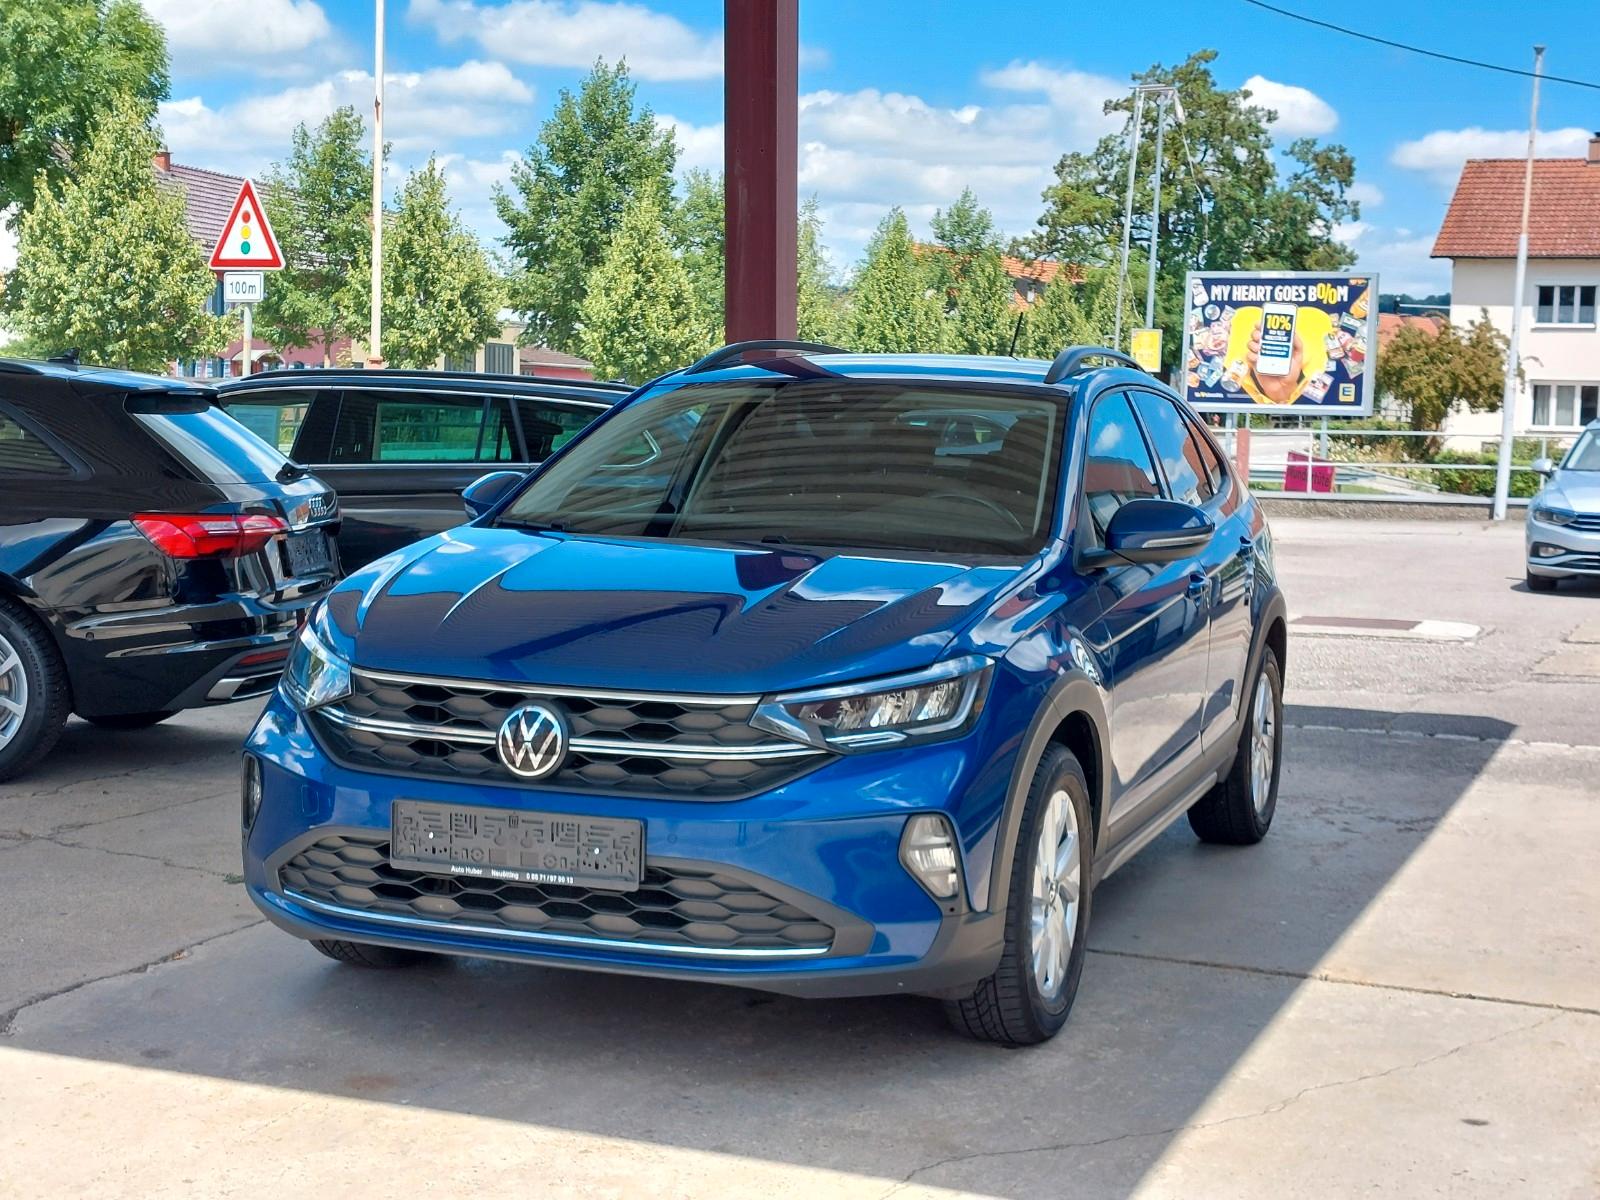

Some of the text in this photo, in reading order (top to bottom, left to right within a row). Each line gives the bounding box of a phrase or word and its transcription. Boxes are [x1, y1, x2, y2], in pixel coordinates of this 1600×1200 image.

[229, 281, 256, 294] 100m
[1211, 285, 1230, 301] MY
[1232, 285, 1272, 302] HEART
[1275, 286, 1306, 302] GOES
[1265, 313, 1292, 331] 10%
[450, 865, 464, 873] Auto
[465, 866, 482, 875] Huber
